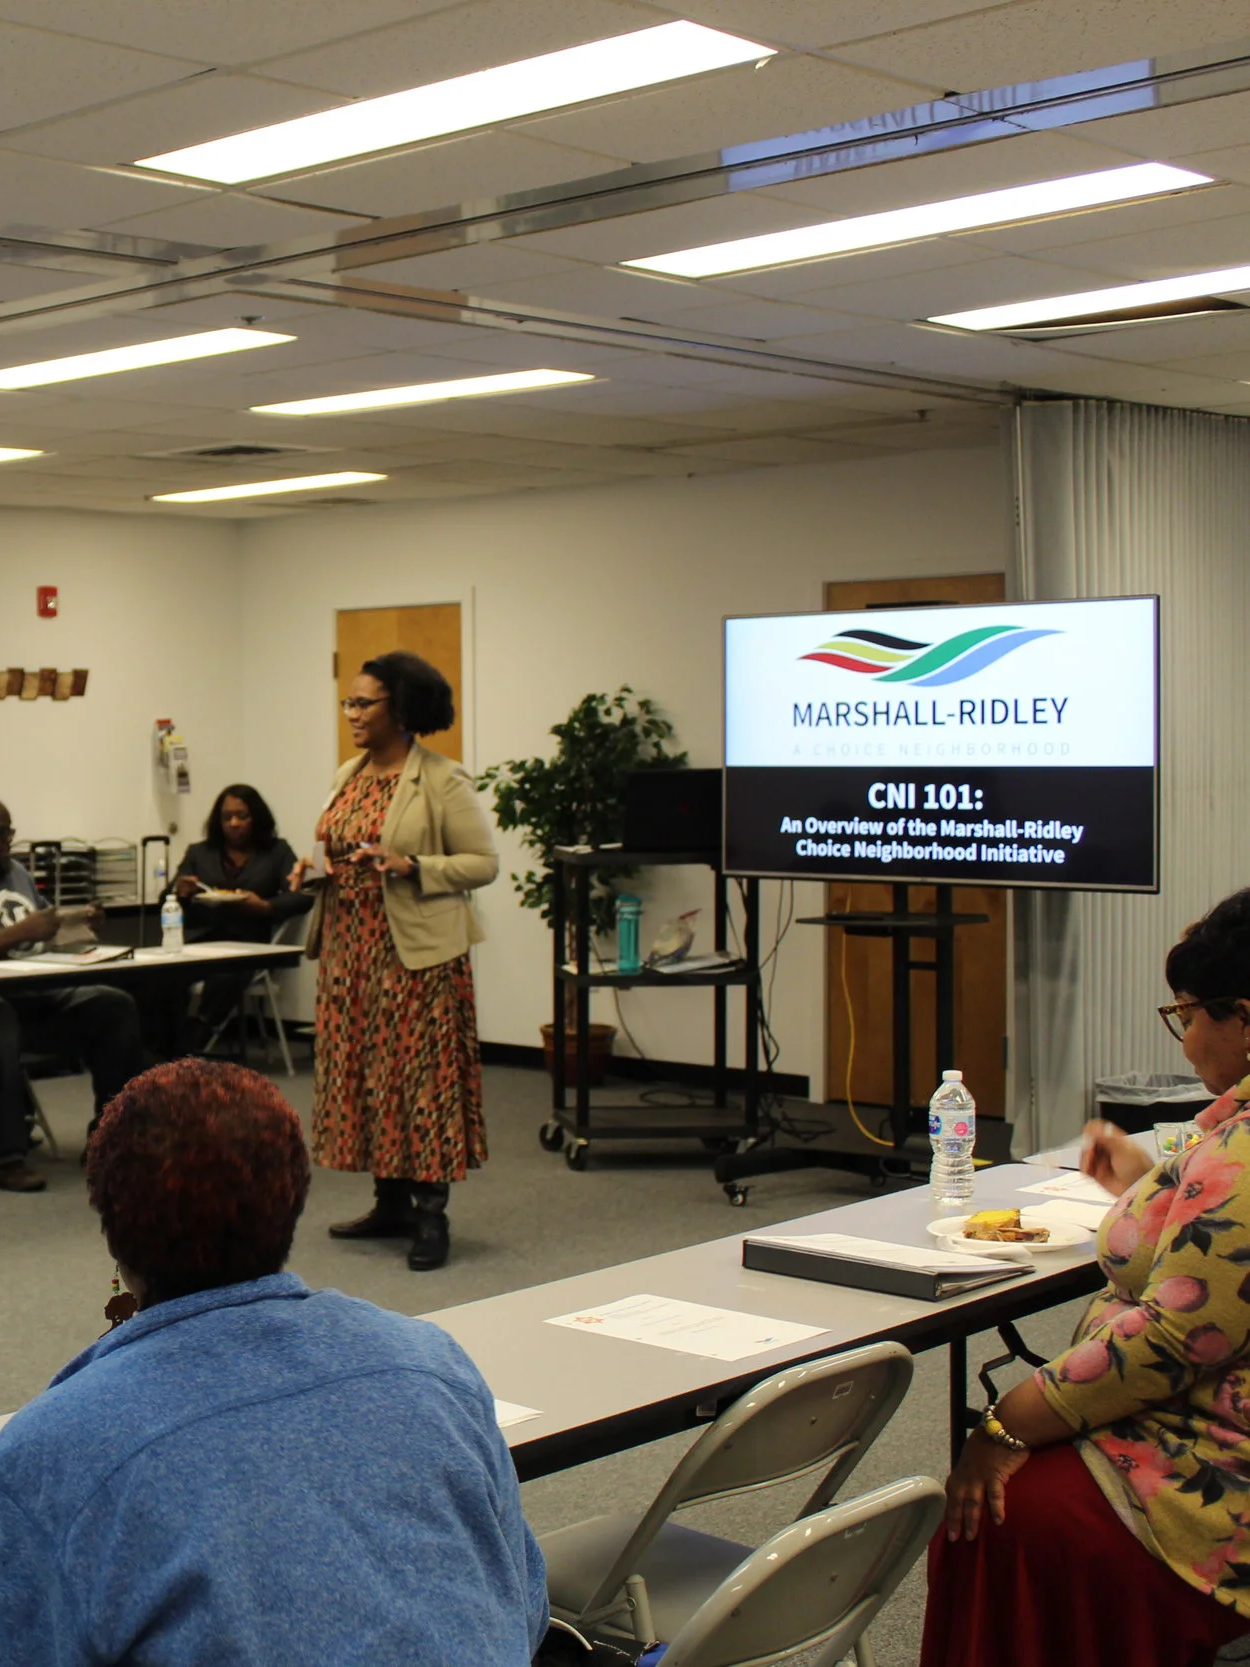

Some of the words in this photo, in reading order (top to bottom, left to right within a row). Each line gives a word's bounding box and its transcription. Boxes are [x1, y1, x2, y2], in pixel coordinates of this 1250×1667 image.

[793, 697, 1068, 727] MARSHALL-RIDLEY
[793, 743, 801, 756] A
[813, 742, 886, 757] CHOICE
[899, 741, 1071, 757] NEIGHBORHOOD
[867, 782, 916, 809] CNI
[923, 783, 984, 811] 101:
[780, 816, 802, 833] An
[804, 816, 884, 835] Overview
[886, 818, 906, 835] of
[907, 818, 937, 836] the
[940, 819, 1084, 844] Marshall-Ridley
[796, 838, 851, 857] Choice
[854, 840, 977, 863] Neighborhood
[981, 843, 1066, 864] Initiative
